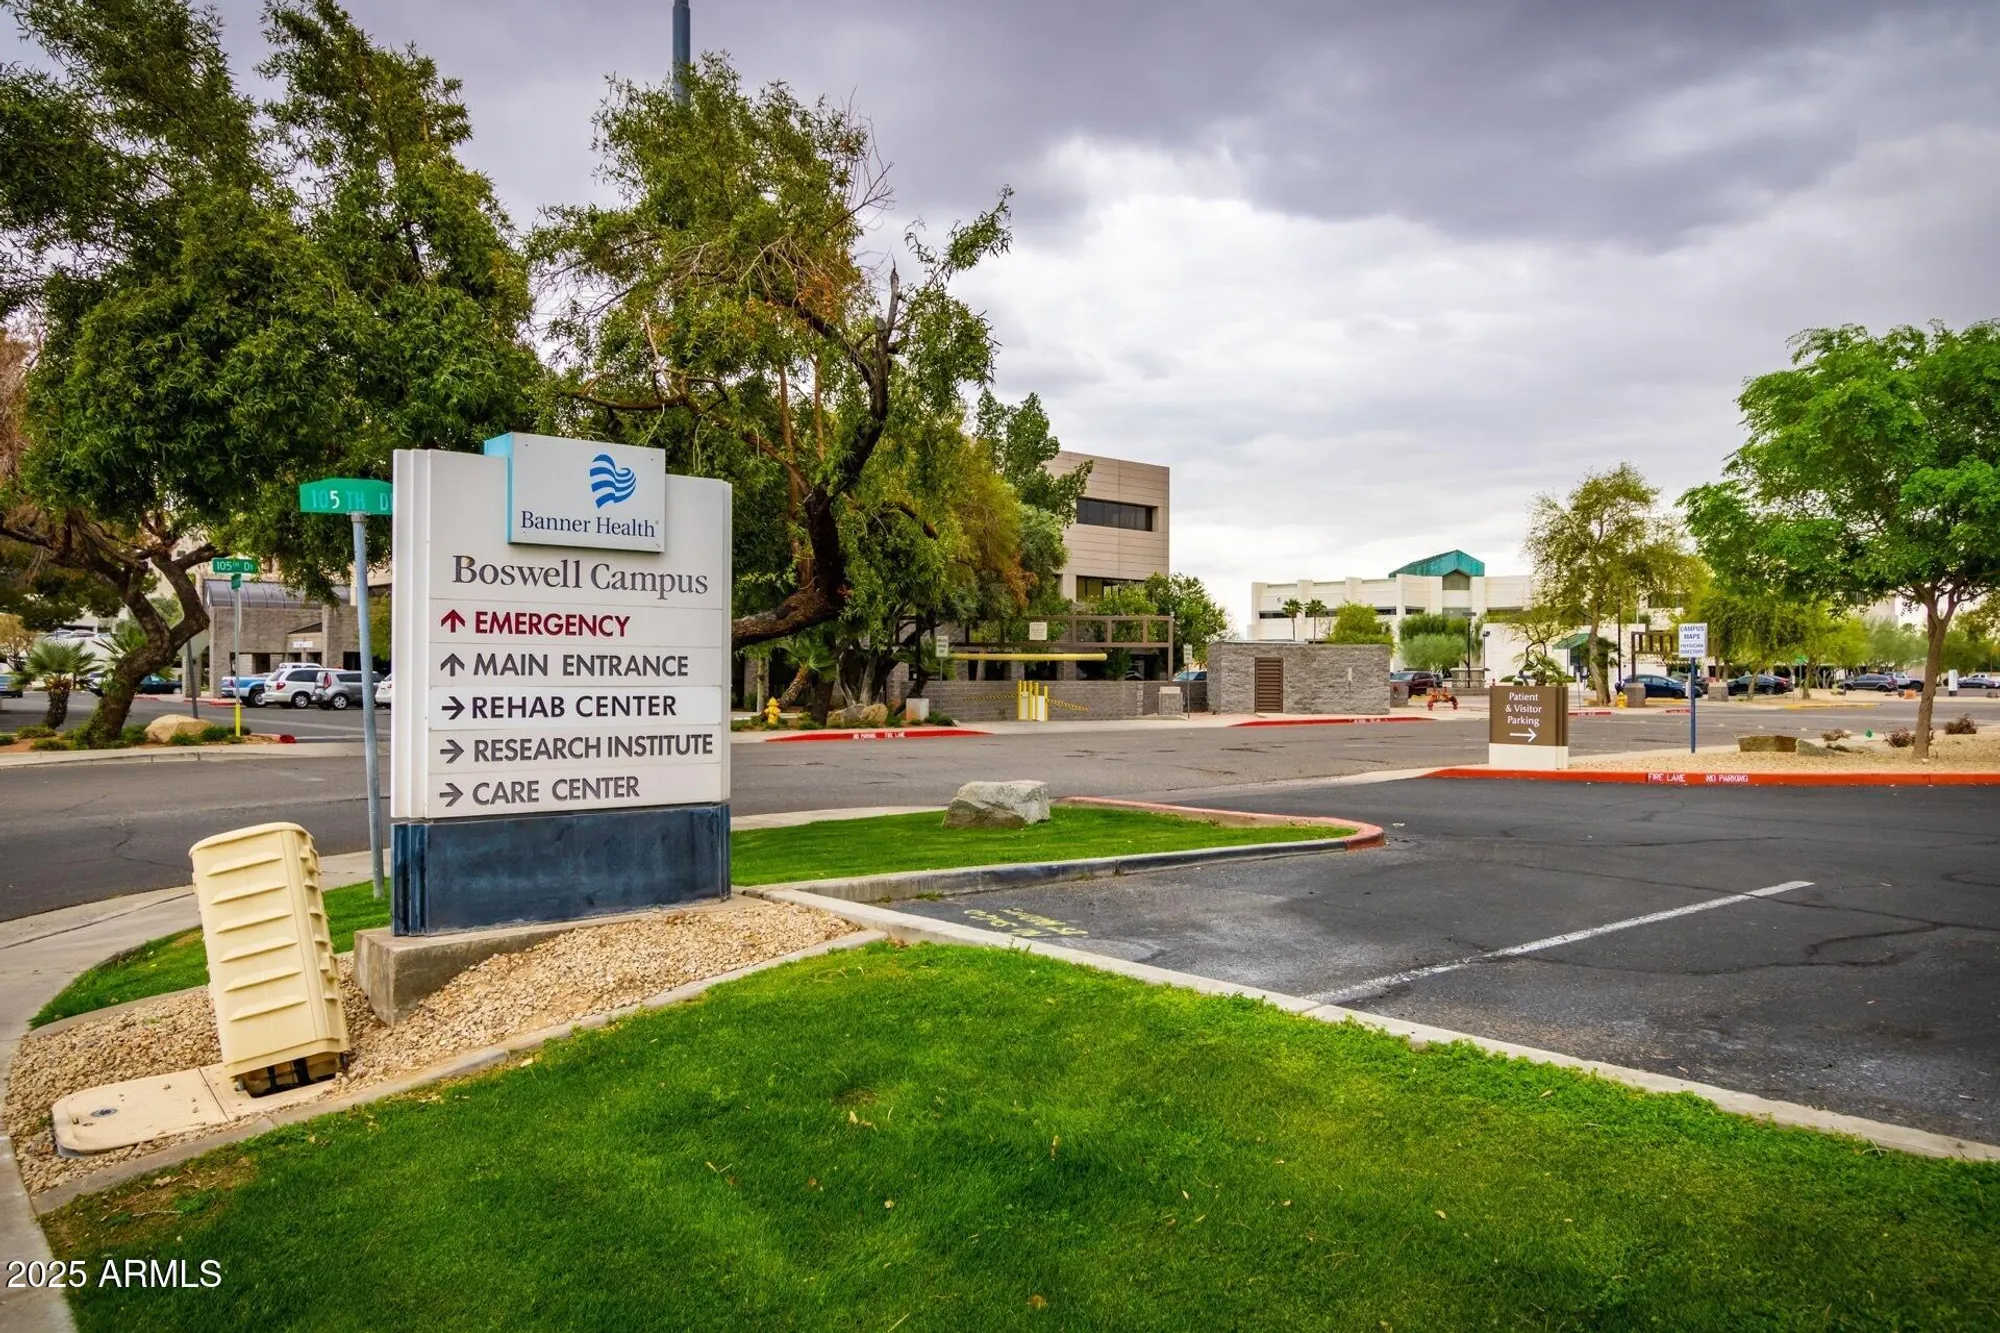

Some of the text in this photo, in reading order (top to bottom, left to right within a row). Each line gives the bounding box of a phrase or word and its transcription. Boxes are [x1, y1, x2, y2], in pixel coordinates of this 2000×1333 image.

[311, 490, 340, 509] 105
[346, 492, 365, 509] TH
[521, 511, 656, 537] Banner Health
[452, 555, 708, 600] Boswell Campus
[475, 611, 631, 637] EMERGENCY
[473, 653, 689, 677] MAIN ENTRANCE
[471, 695, 677, 719] REHAB CENTER
[1505, 704, 1542, 713] & Visitor
[1509, 692, 1538, 701] Patient
[1507, 715, 1540, 728] Parking
[474, 734, 713, 762] RESEARCH INSTITUTE
[1648, 773, 1686, 782] FIRE LANE
[1706, 774, 1749, 783] NO PARKING
[472, 776, 640, 805] CARE CENTER
